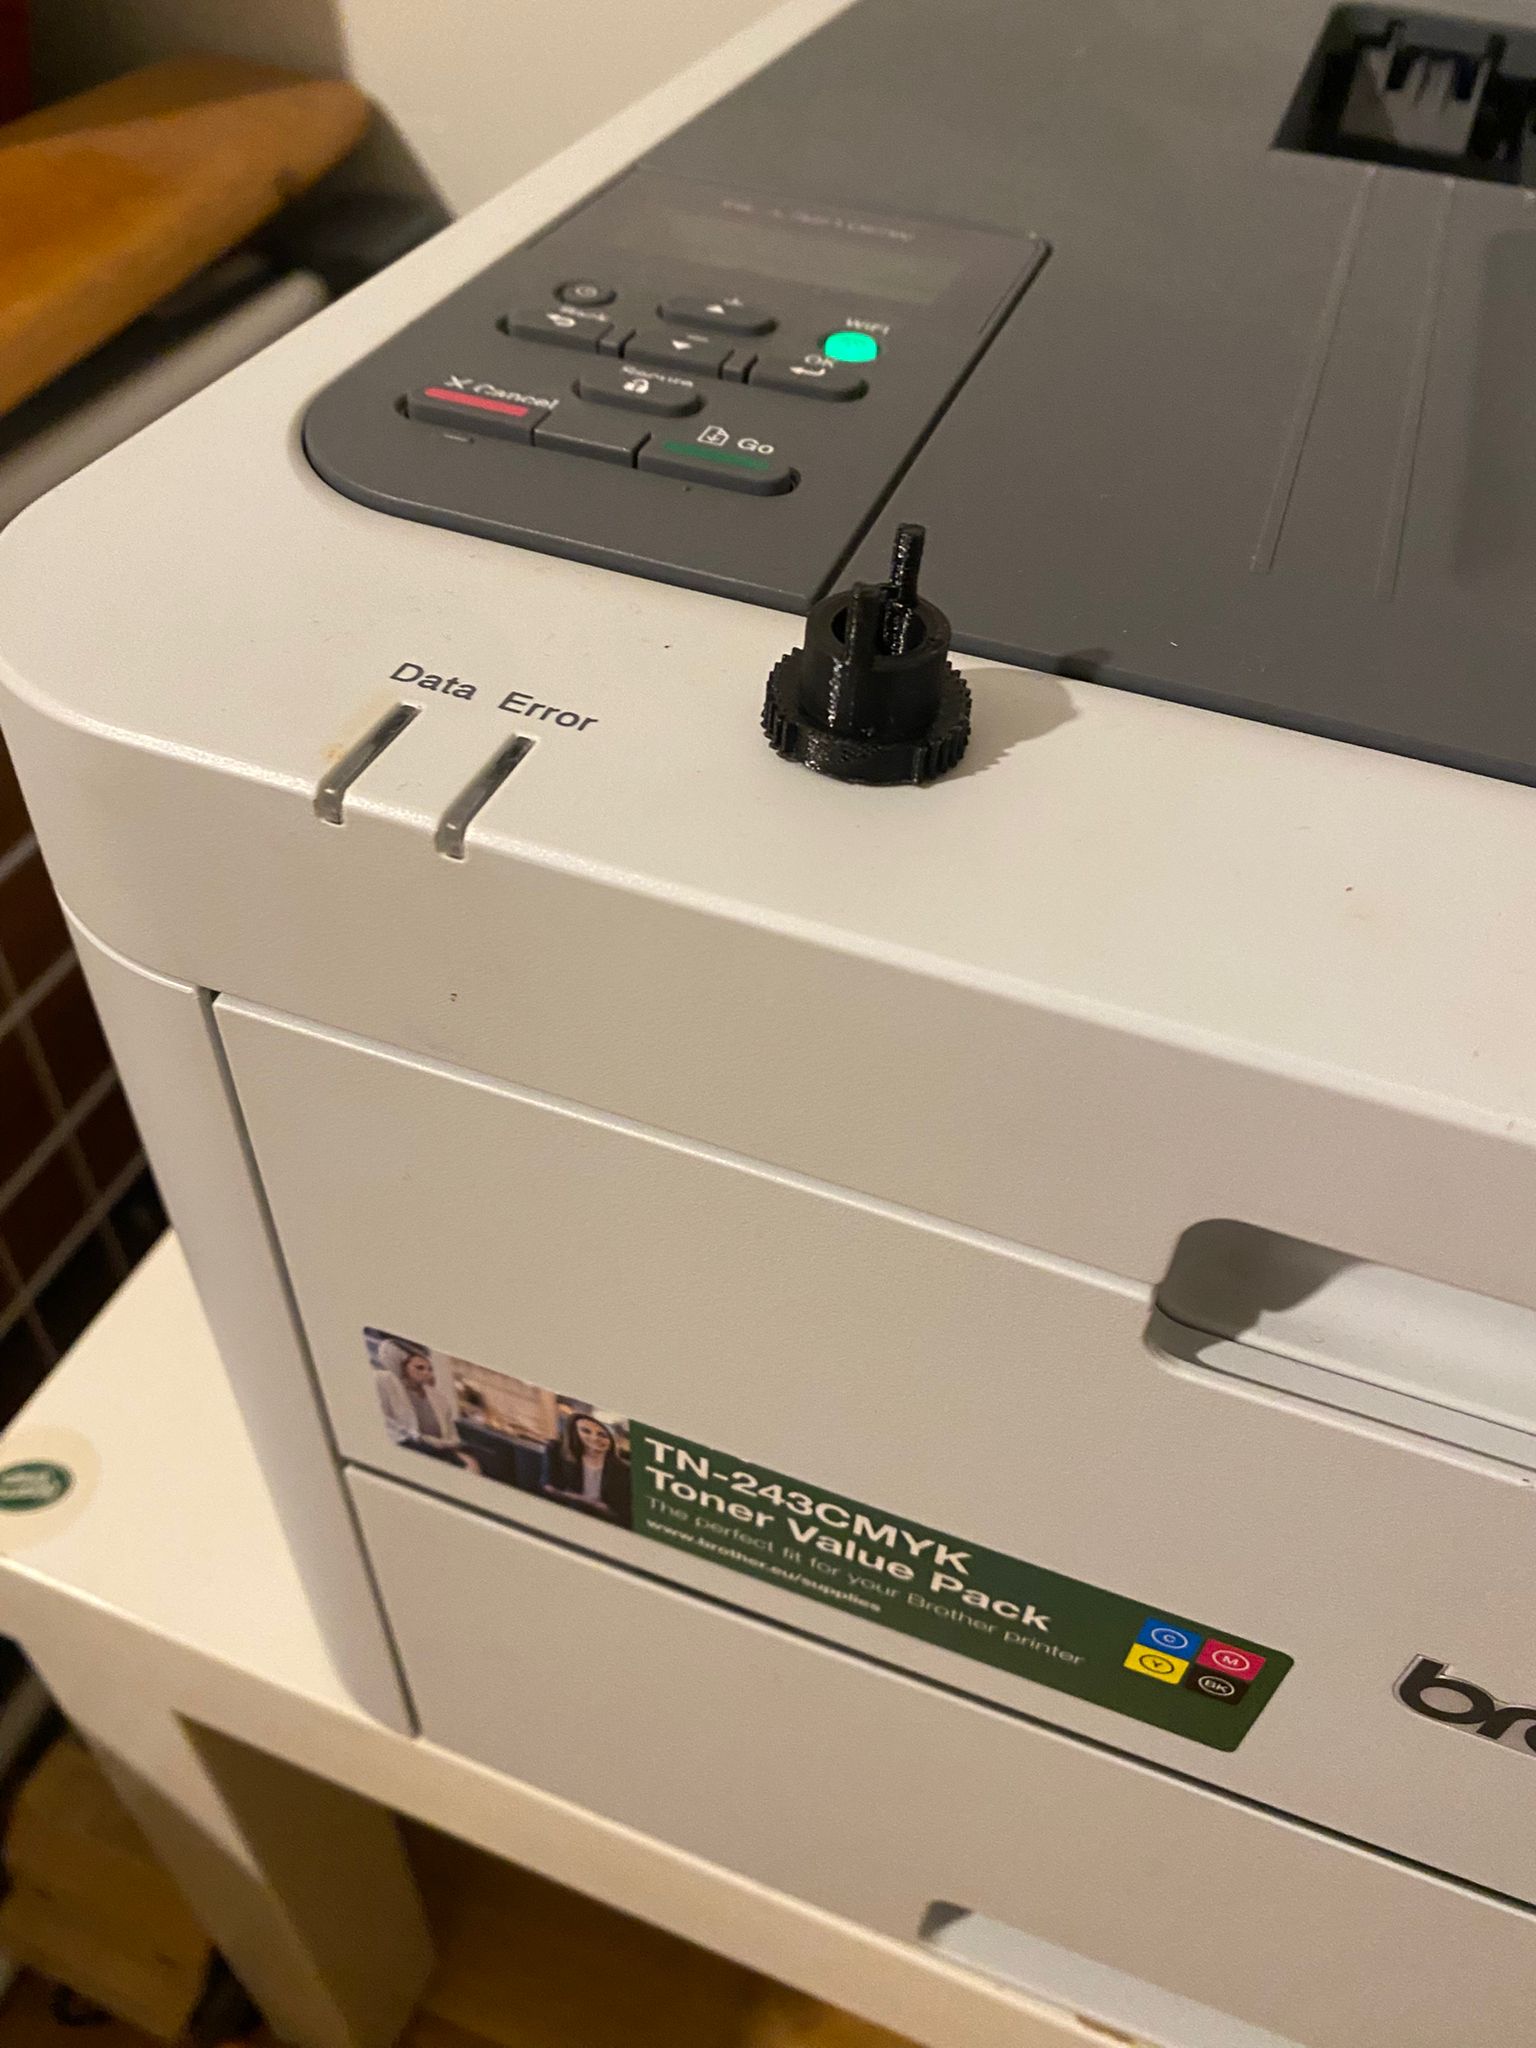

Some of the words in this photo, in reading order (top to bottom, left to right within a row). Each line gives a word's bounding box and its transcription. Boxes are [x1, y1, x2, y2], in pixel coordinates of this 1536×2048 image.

[473, 383, 559, 410] Cancel
[737, 437, 775, 454] Go
[389, 662, 478, 701] Data
[497, 691, 599, 732] Error
[644, 1436, 973, 1576] TN-243CMYK
[645, 1465, 775, 1529] Toner
[787, 1515, 915, 1581] Value
[930, 1570, 1051, 1633] Pack
[645, 1518, 882, 1613] www.brother.eu/supplies
[646, 1496, 690, 1522] The
[694, 1514, 774, 1553] perfect
[782, 1546, 802, 1563] fit
[810, 1556, 842, 1576] for
[848, 1572, 899, 1599] your
[907, 1592, 998, 1635] Brother
[1002, 1629, 1086, 1665] printer
[1204, 1679, 1229, 1693] BK
[1395, 1655, 1536, 1757] br
